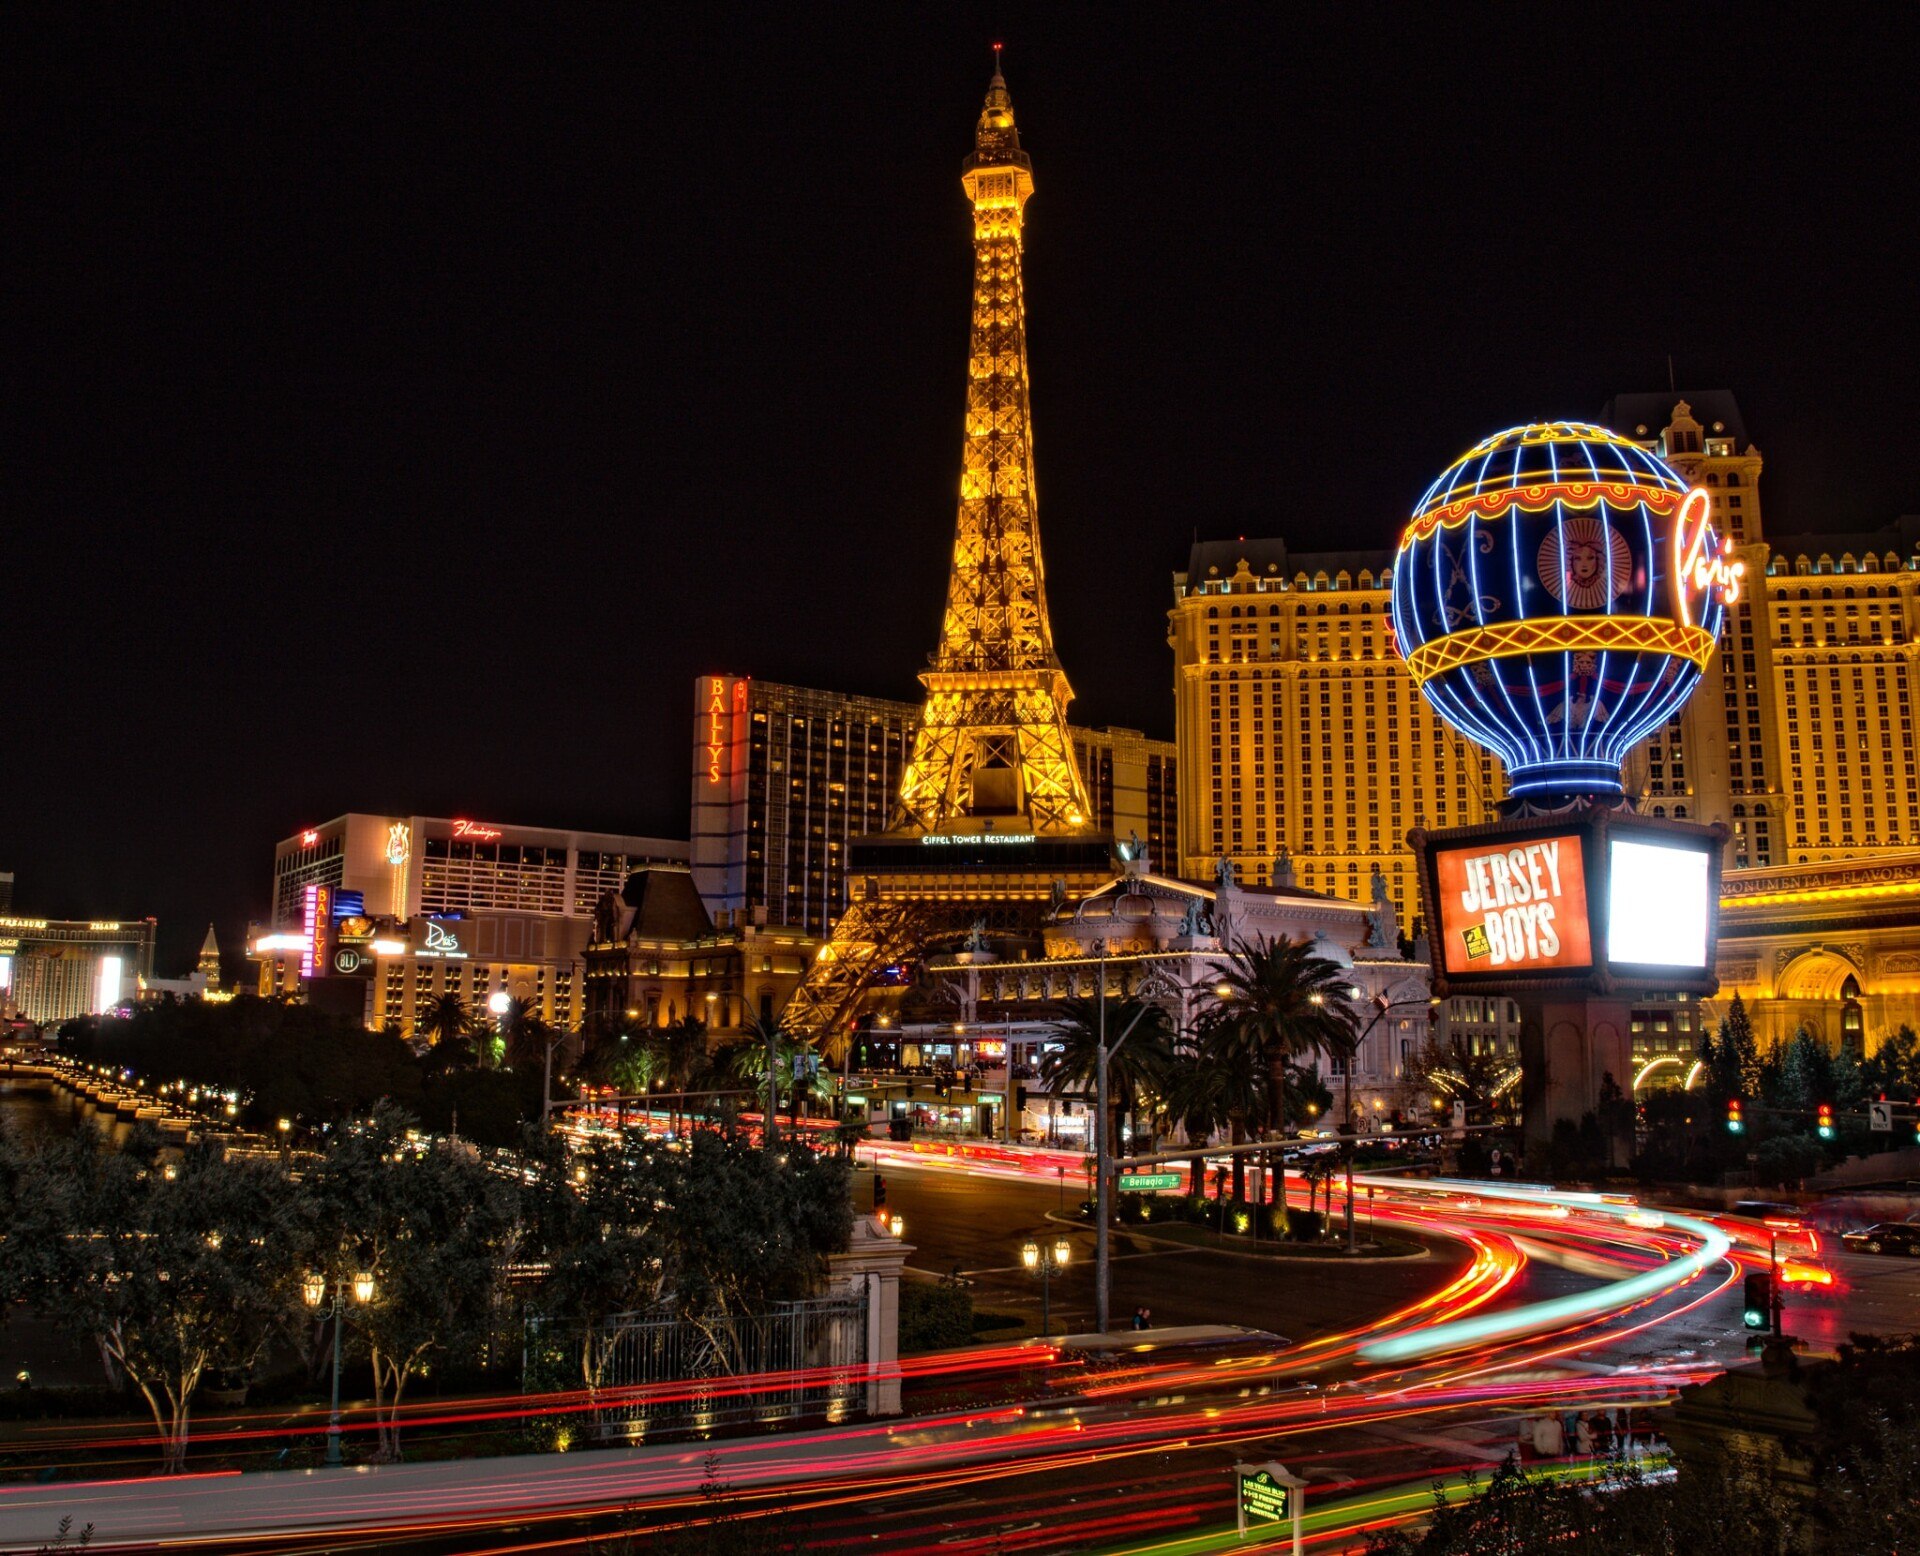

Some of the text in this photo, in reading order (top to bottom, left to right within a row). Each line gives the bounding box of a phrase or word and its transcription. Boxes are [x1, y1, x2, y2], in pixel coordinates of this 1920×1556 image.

[1675, 488, 1744, 628] Paris
[707, 679, 725, 782] BALLYS
[453, 820, 501, 840] Flamingo
[922, 835, 1035, 844] EIFFEL TOWER RESTAURANT
[1461, 841, 1562, 913] JERSEY
[1720, 866, 1914, 894] MONUMENTAL FLAVORS
[0, 919, 119, 931] TREASURE ISLAND
[314, 889, 327, 967] BALLYS
[1484, 902, 1560, 965] BOYS
[0, 939, 19, 947] AGE
[340, 953, 354, 968] BLT
[1129, 1178, 1163, 1188] Bellagio
[1243, 1479, 1286, 1498] LAS VEGAS BLVD
[1249, 1505, 1279, 1520] DOWNTOWN
[1252, 1500, 1275, 1511] AIRPORT
